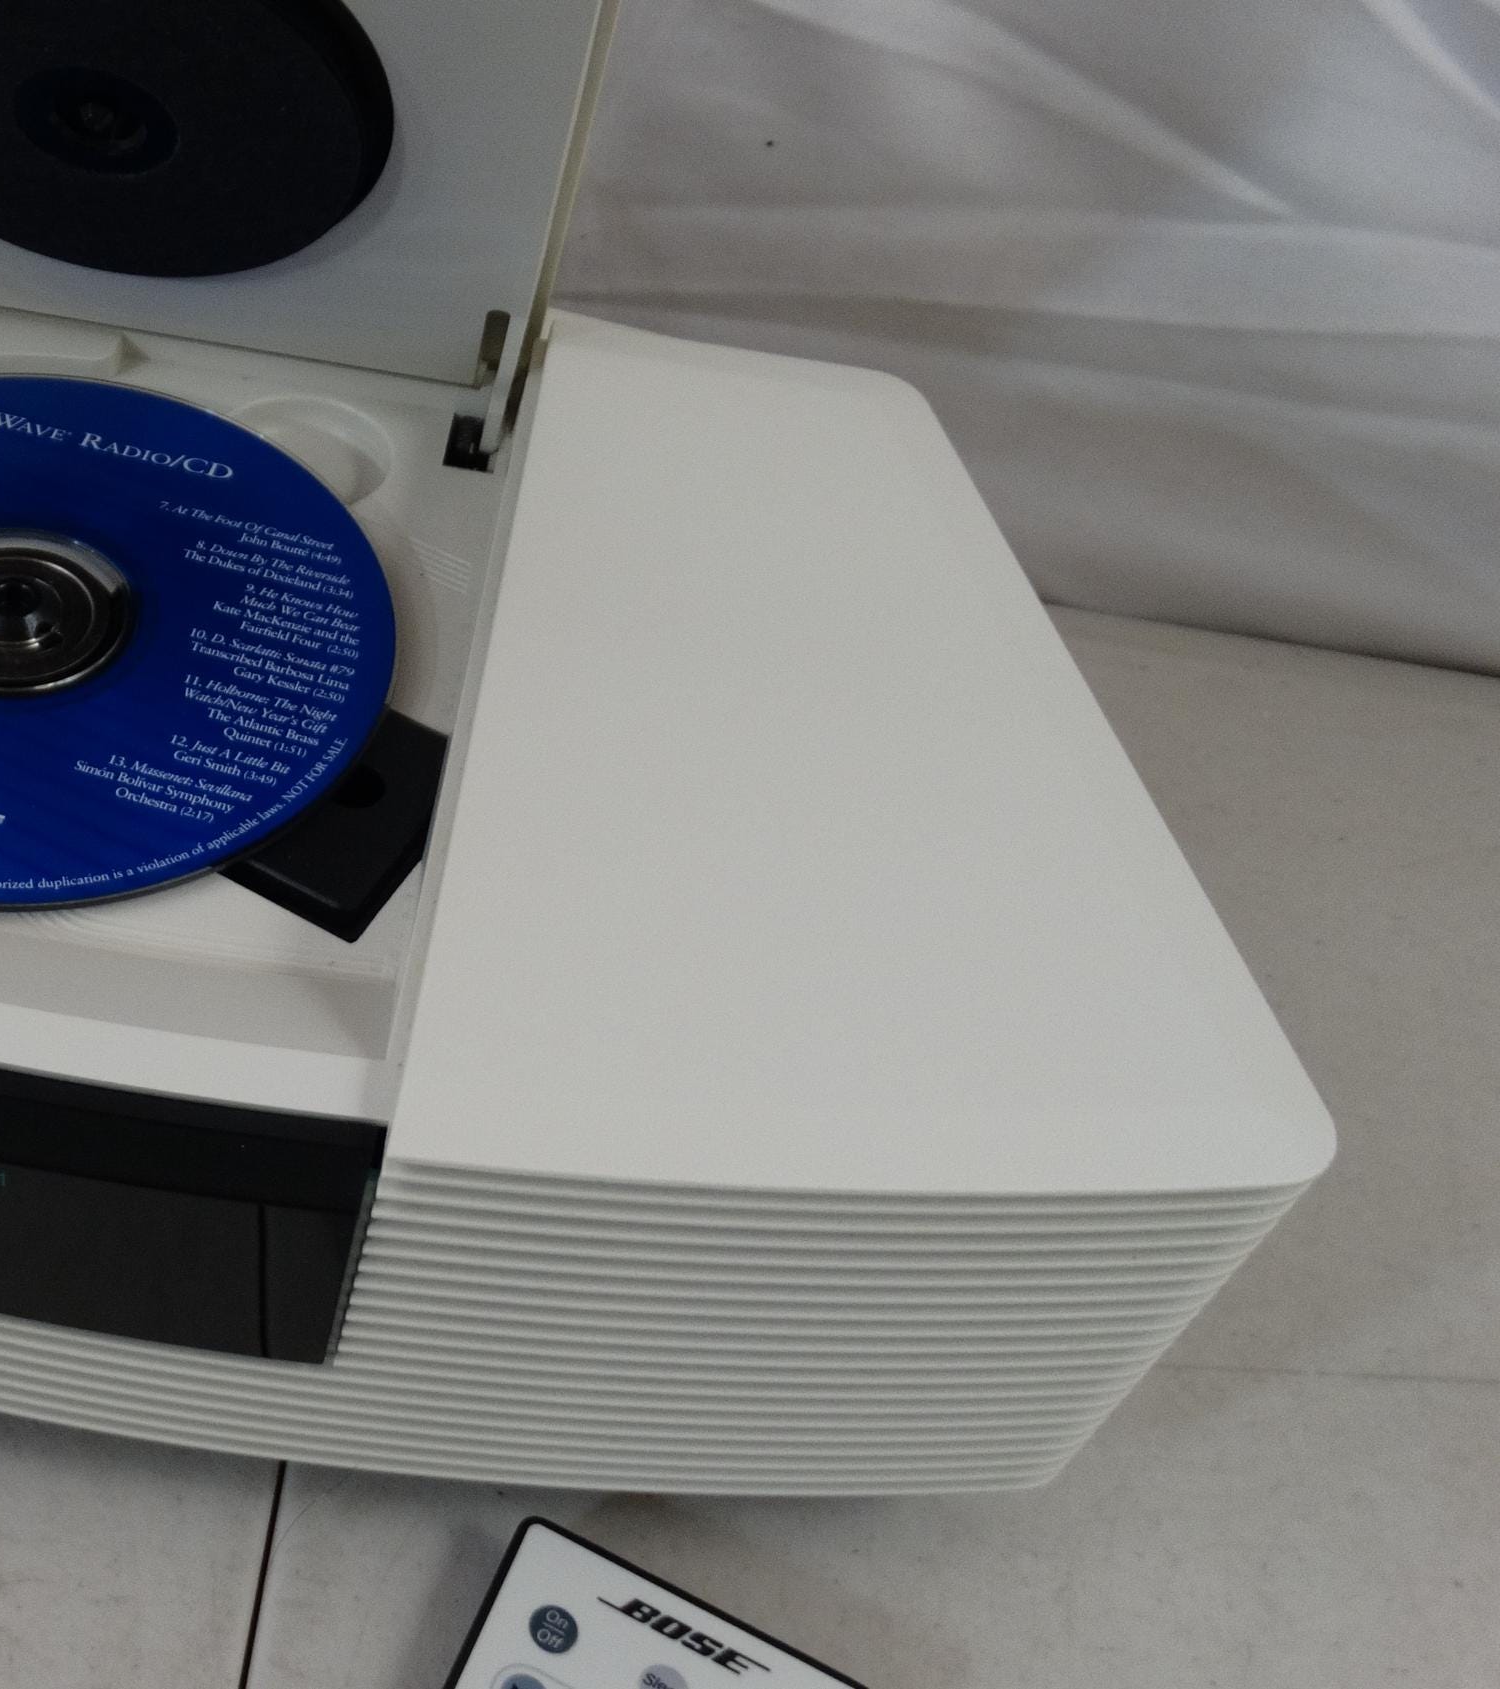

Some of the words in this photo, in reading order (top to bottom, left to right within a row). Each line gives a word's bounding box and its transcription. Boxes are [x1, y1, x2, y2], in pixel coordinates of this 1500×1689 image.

[79, 431, 234, 480] RADIO/CD
[159, 500, 170, 511] 7.
[171, 505, 189, 515] At
[191, 508, 213, 521] The
[214, 514, 243, 528] Foot
[244, 522, 264, 534] Of
[264, 527, 301, 542] Canal
[300, 535, 334, 551] Street
[239, 532, 268, 547] John
[183, 548, 206, 562] The
[208, 555, 245, 572] Dukes
[247, 567, 261, 576] of
[263, 569, 321, 591] Dixieland
[195, 540, 206, 550] 8.
[209, 543, 248, 560] Down
[250, 553, 265, 566] By
[271, 558, 294, 571] The
[296, 564, 351, 585] Riverside
[240, 595, 276, 610] Much
[281, 604, 301, 617] We
[303, 611, 329, 625] Can
[331, 618, 361, 632] Bear
[246, 583, 255, 594] 9.
[259, 587, 279, 599] He
[280, 592, 323, 610] Knows
[325, 603, 359, 619] How
[213, 600, 241, 616] Kate
[244, 609, 312, 633] MacKenzie
[313, 629, 338, 640] and
[339, 633, 360, 646] the
[240, 620, 290, 641] Fairfield
[291, 634, 321, 649] Four
[190, 627, 207, 640] 10.
[211, 633, 226, 645] D.
[283, 652, 327, 671] Sonata
[329, 664, 356, 676] #79
[192, 640, 263, 667] Transcribed
[265, 660, 314, 681] Barbosa
[317, 674, 350, 691] Lima
[184, 674, 202, 687] 11.
[206, 680, 270, 704] Holborne:
[274, 696, 298, 711] The
[299, 704, 338, 722] Night
[233, 666, 263, 683] Gary
[267, 674, 310, 694] Kessler
[208, 707, 231, 722] The
[234, 716, 283, 736] Atlantic
[285, 728, 319, 746] Brass
[223, 727, 271, 748] Quintet
[262, 707, 297, 725] Year's
[301, 719, 328, 734] Gift
[170, 734, 188, 748] 12.
[189, 740, 218, 755] Just
[218, 748, 231, 759] A
[234, 751, 269, 768] Little
[270, 761, 291, 774] Bit
[173, 750, 201, 766] Geri
[203, 758, 241, 776] Smith
[109, 754, 127, 769] 13.
[131, 760, 193, 786] Massenet:
[195, 779, 253, 802] Sevillana
[115, 787, 177, 813] Orchestra
[165, 785, 234, 813] Symphony
[38, 873, 109, 890] duplication
[113, 868, 123, 880] is
[137, 852, 190, 873] violation
[192, 842, 205, 856] of
[207, 817, 260, 852] applicable
[258, 802, 286, 821] laws.
[281, 779, 309, 803] NOT
[304, 761, 329, 782] FOR
[546, 1609, 569, 1629] On
[597, 1597, 770, 1675] BOSE
[537, 1630, 563, 1650] Off
